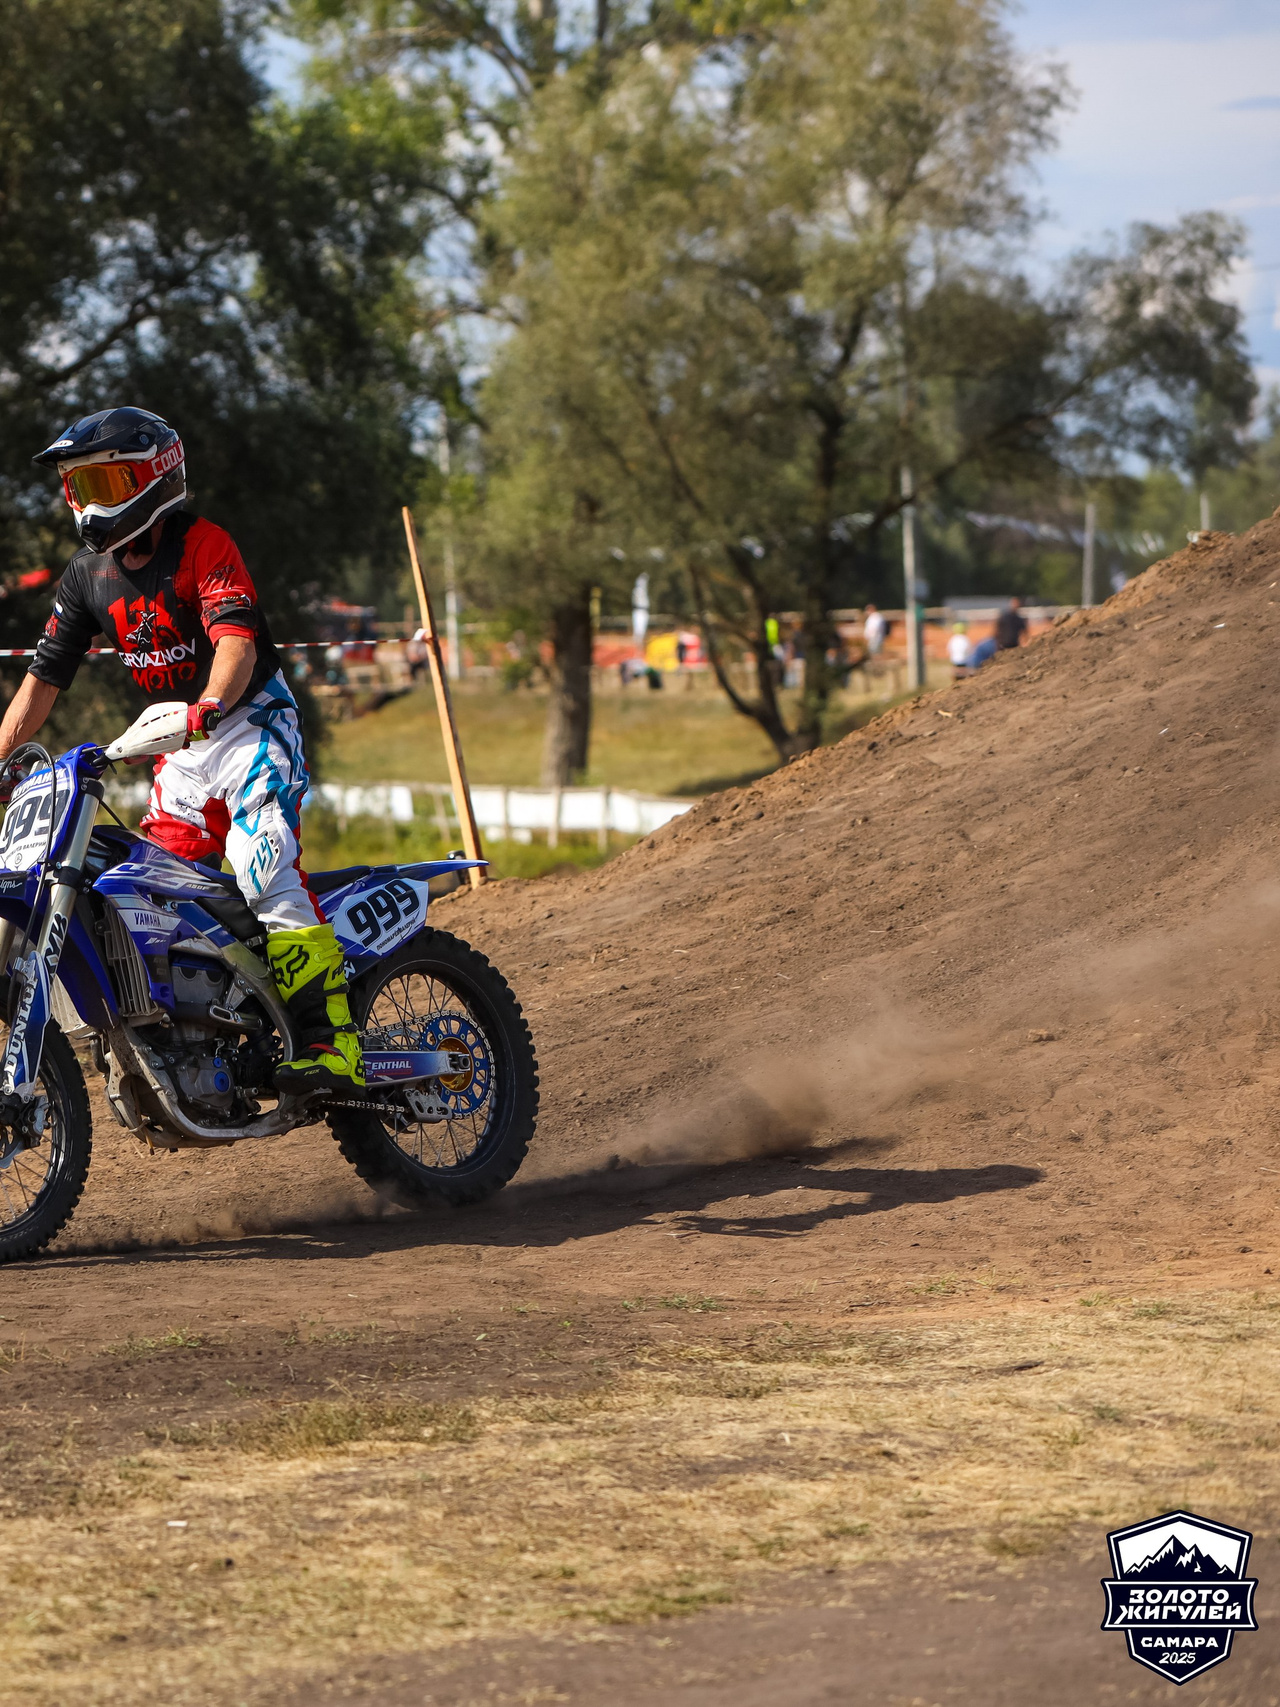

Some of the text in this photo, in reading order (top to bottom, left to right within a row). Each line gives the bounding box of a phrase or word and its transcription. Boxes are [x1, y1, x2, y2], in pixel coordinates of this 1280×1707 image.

[119, 638, 196, 668] GRYAZNOV
[132, 661, 197, 694] MOTO
[134, 912, 162, 928] YAMAHA
[346, 879, 420, 948] 999
[365, 1060, 412, 1070] ENTHAL
